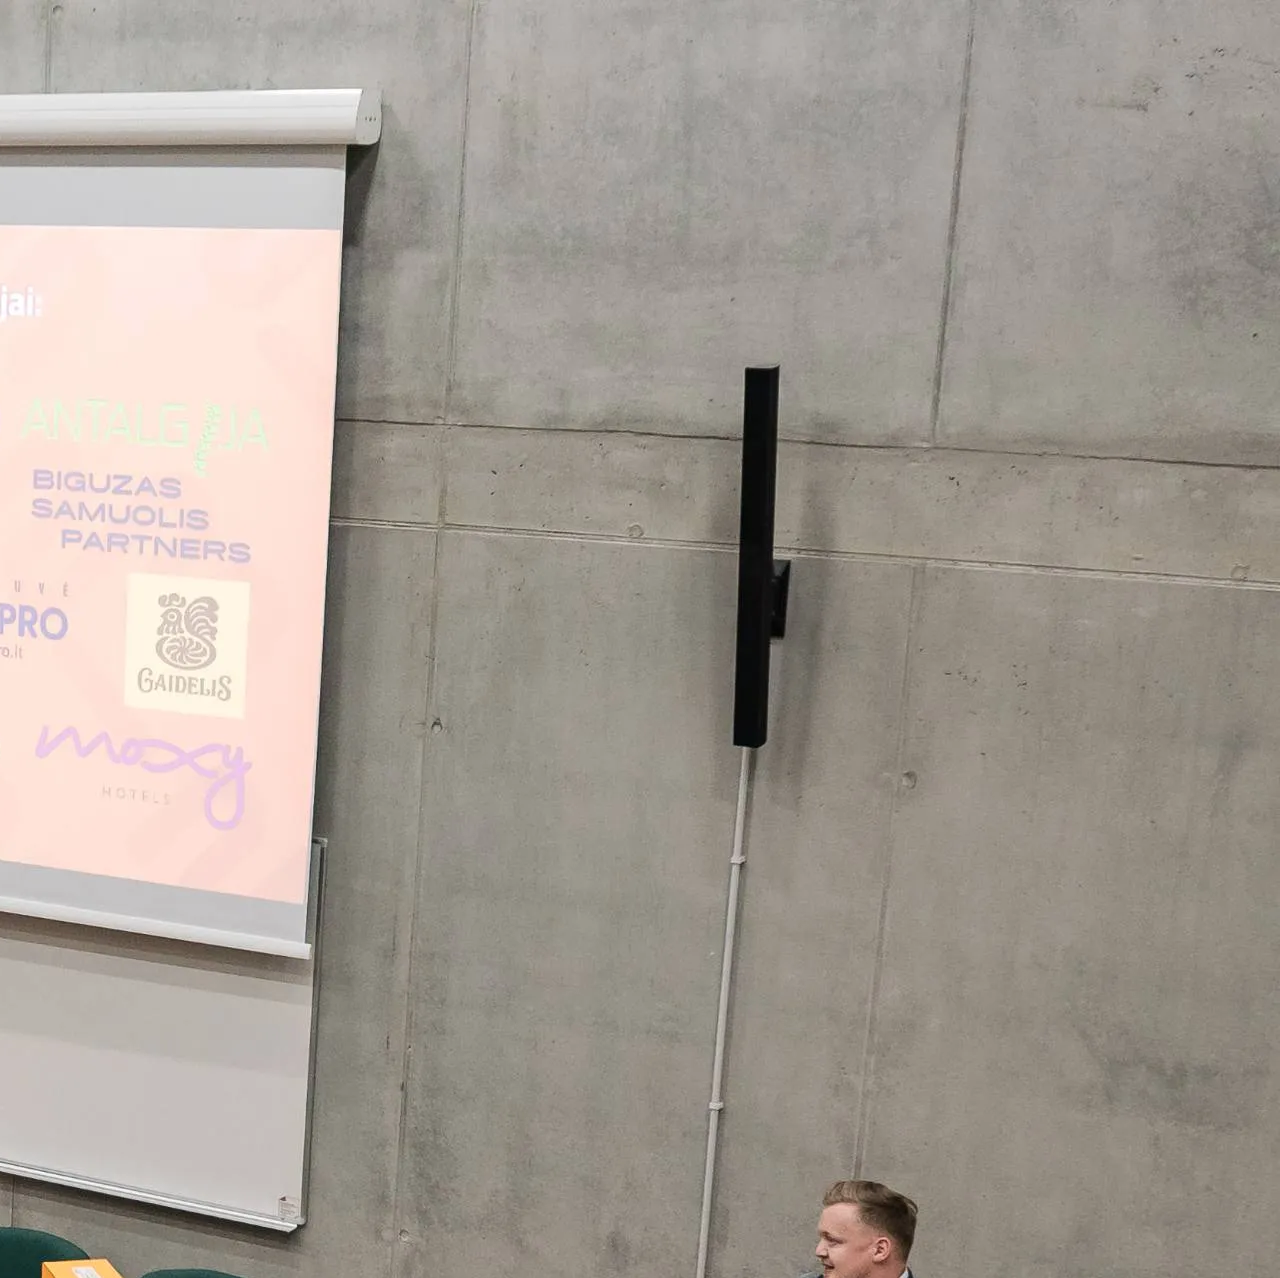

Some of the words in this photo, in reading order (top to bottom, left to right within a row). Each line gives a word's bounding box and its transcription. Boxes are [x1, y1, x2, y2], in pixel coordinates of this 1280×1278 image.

[32, 469, 182, 499] BIGUZAS
[31, 498, 210, 530] SAMUOLIS
[61, 528, 251, 564] PARTNERS
[137, 667, 233, 701] GAIDELIS
[102, 786, 172, 806] HOTELS
